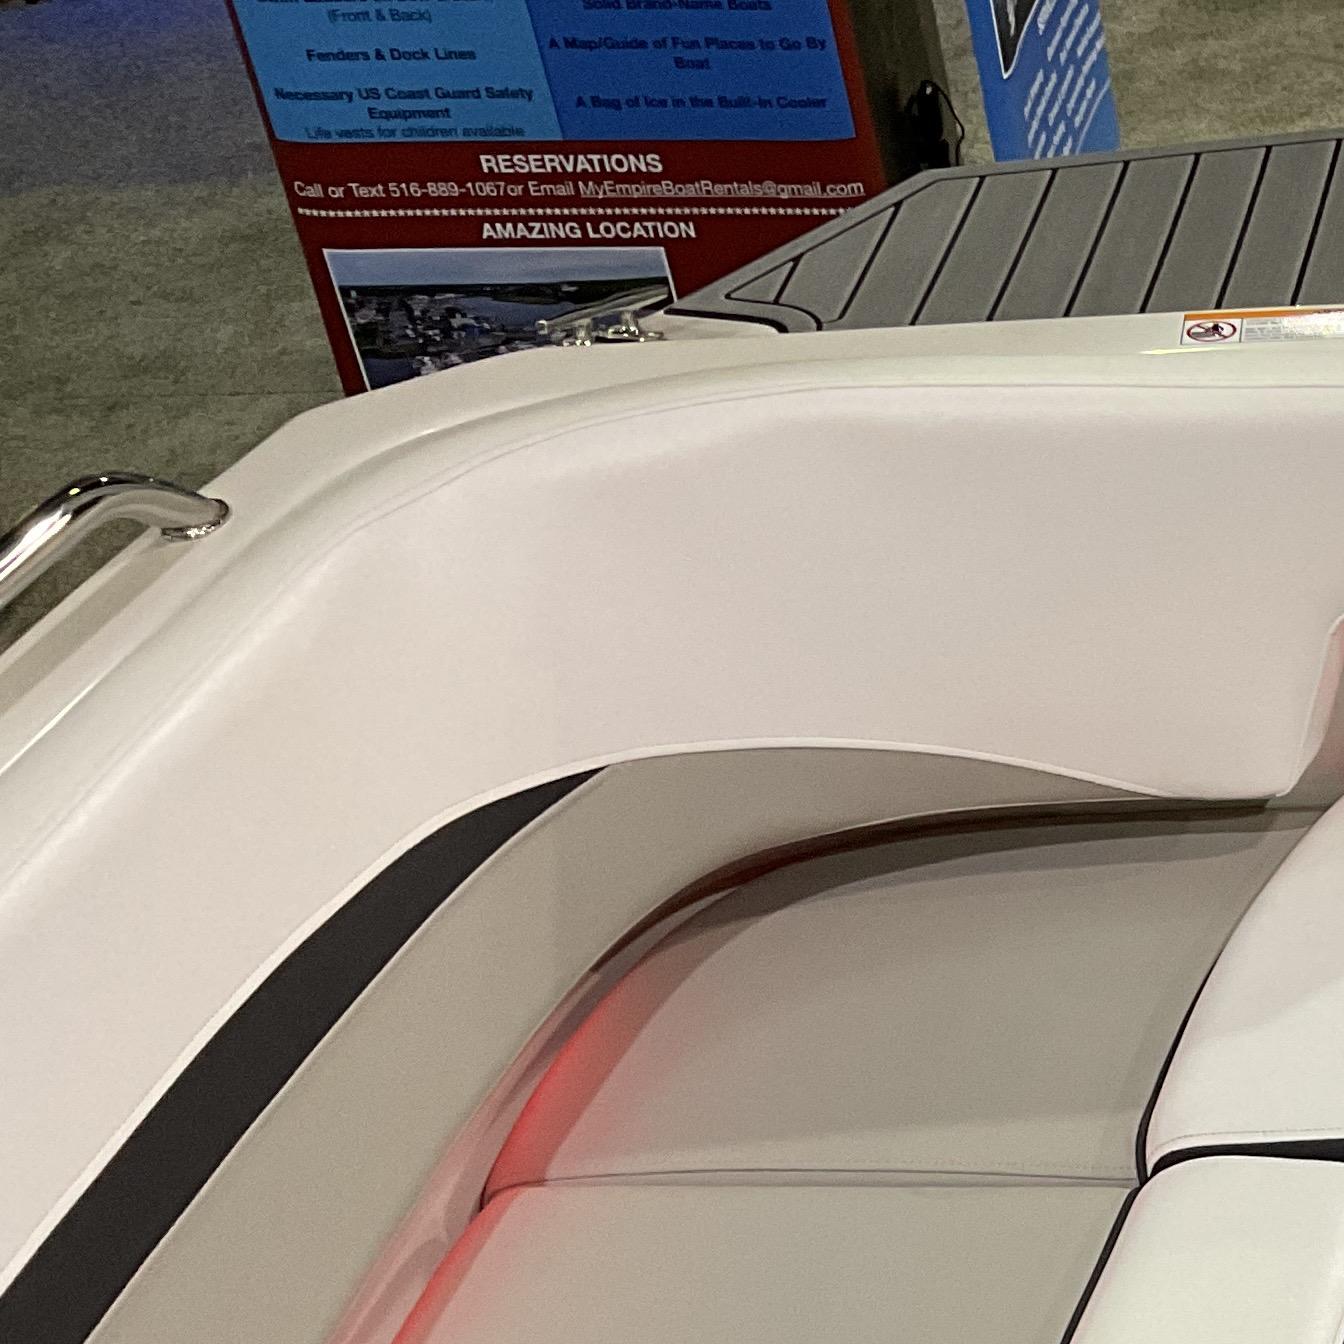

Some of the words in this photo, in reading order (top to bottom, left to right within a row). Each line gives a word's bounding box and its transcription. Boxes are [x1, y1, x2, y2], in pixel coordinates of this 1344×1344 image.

[328, 8, 372, 25] (Front
[376, 9, 386, 22] &
[391, 8, 432, 24] Back)
[549, 37, 561, 49] A
[563, 37, 649, 52] Map/Guide
[653, 37, 667, 49] of
[671, 37, 700, 49] Fun
[704, 37, 756, 49] Places
[759, 38, 774, 50] to
[779, 37, 801, 50] Go
[806, 36, 827, 51] By
[306, 48, 371, 62] Fenders
[375, 48, 387, 61] &
[390, 48, 429, 61] Dock
[435, 48, 476, 61] Lines
[274, 87, 353, 103] Necessary
[358, 88, 380, 100] US
[385, 87, 430, 101] Coast
[435, 87, 481, 100] Guard
[485, 86, 534, 102] Safety
[367, 106, 452, 121] Equipment
[305, 127, 331, 140] Life
[336, 127, 374, 139] vests
[378, 126, 396, 139] for
[401, 126, 458, 138] children
[462, 125, 525, 138] available
[479, 153, 663, 173] RESERVATIONS
[294, 181, 323, 198] Call
[328, 186, 344, 198] or
[348, 183, 384, 198] Text
[528, 181, 575, 197] Email
[579, 179, 865, 199] MyEmpireBoatRentals@gmail.com
[482, 222, 582, 239] AMAZING
[586, 220, 697, 239] LOCATION
